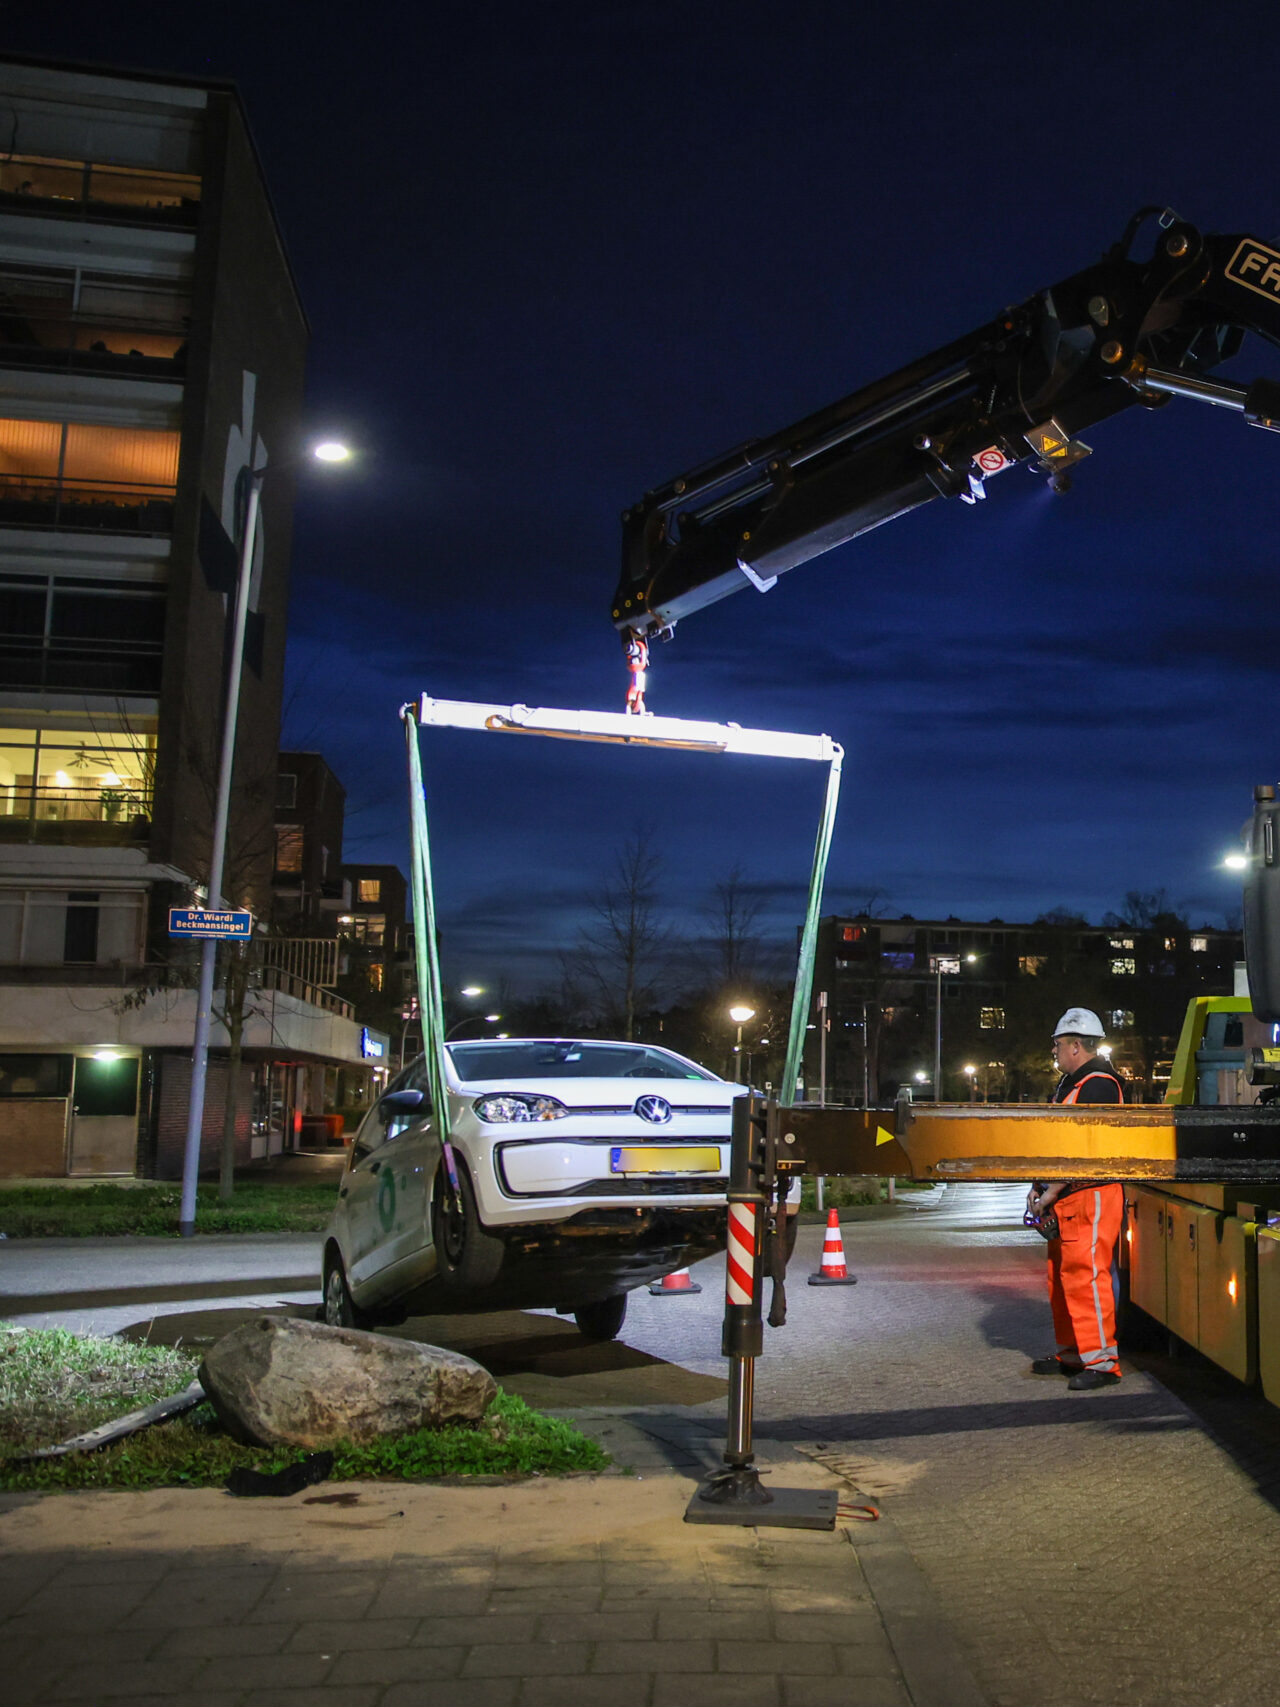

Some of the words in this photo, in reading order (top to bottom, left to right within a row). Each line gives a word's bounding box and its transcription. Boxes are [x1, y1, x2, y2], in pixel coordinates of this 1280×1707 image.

[188, 912, 202, 921] Dr.
[203, 913, 233, 921] Wiardi
[176, 920, 244, 931] Beckmansingel
